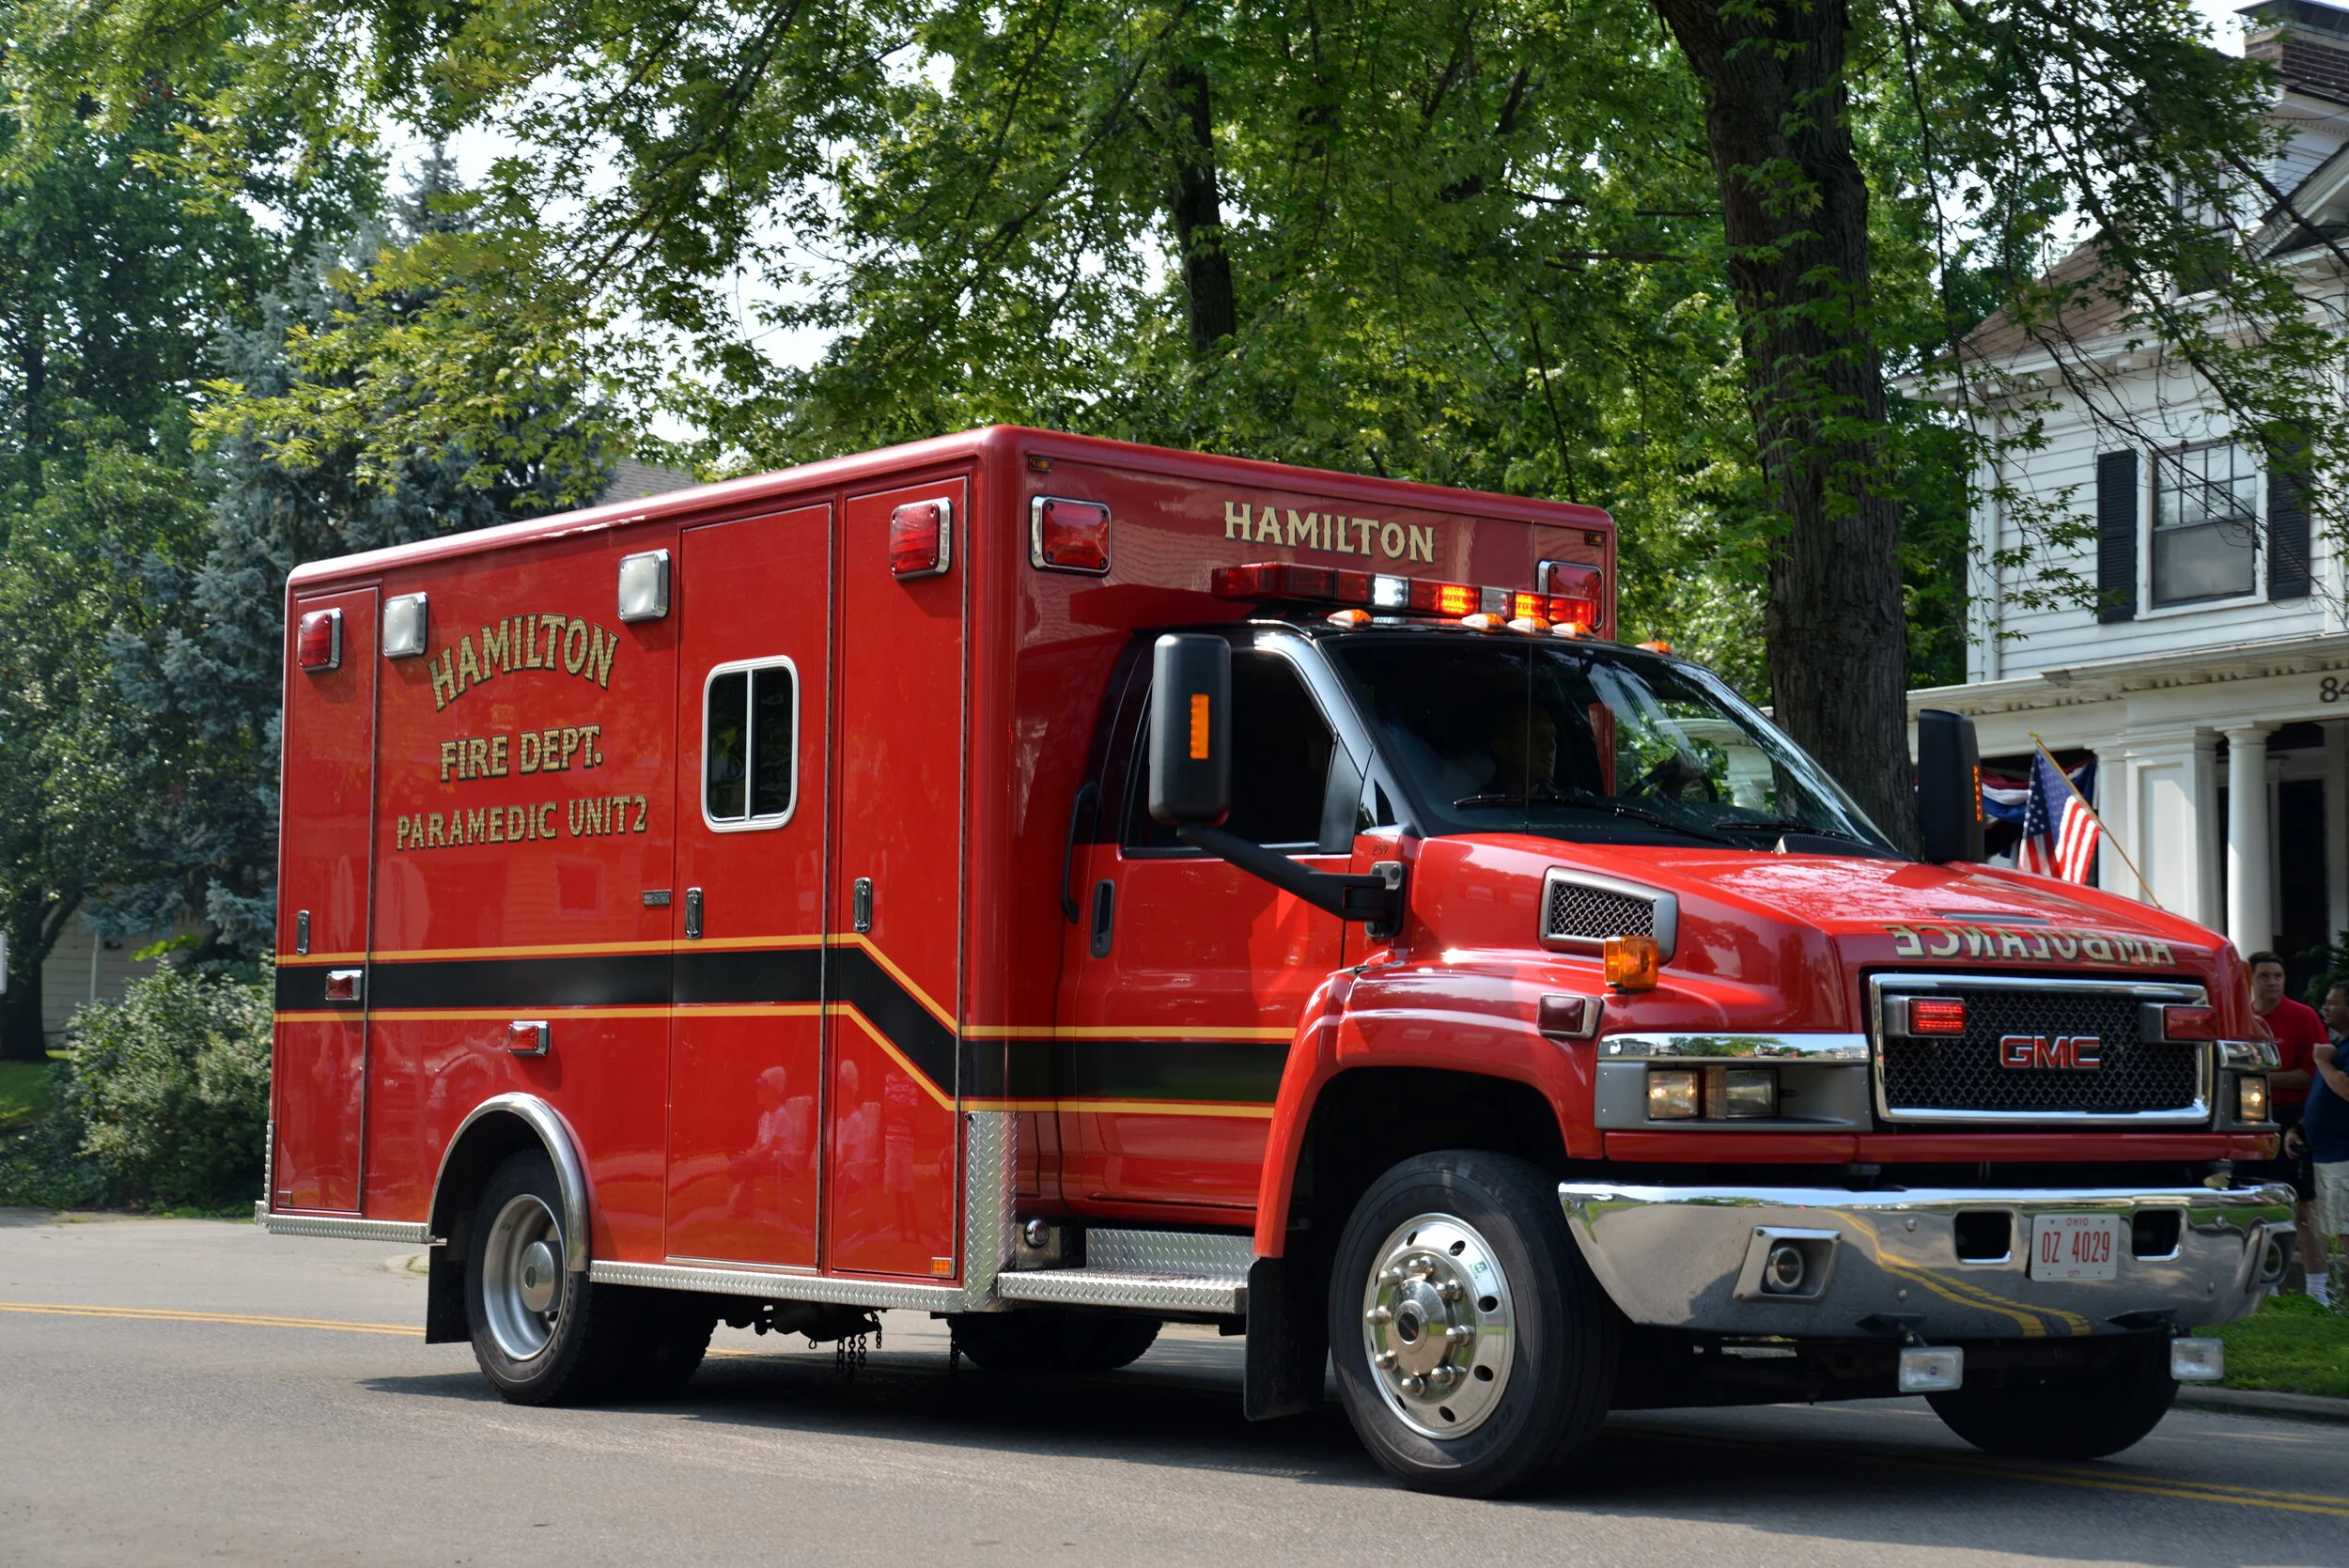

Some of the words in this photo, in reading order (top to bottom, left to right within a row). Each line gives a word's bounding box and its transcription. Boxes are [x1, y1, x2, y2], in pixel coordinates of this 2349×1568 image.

[1223, 500, 1435, 564] HAMILTON
[428, 613, 619, 711] HAMILTON
[440, 736, 508, 782] FIRE
[518, 724, 603, 774] DEPT.
[397, 801, 558, 850] PARAMEDIC
[1999, 1034, 2101, 1069] GMC
[2066, 1217, 2090, 1227] OHIO
[2072, 1231, 2111, 1264] 4029
